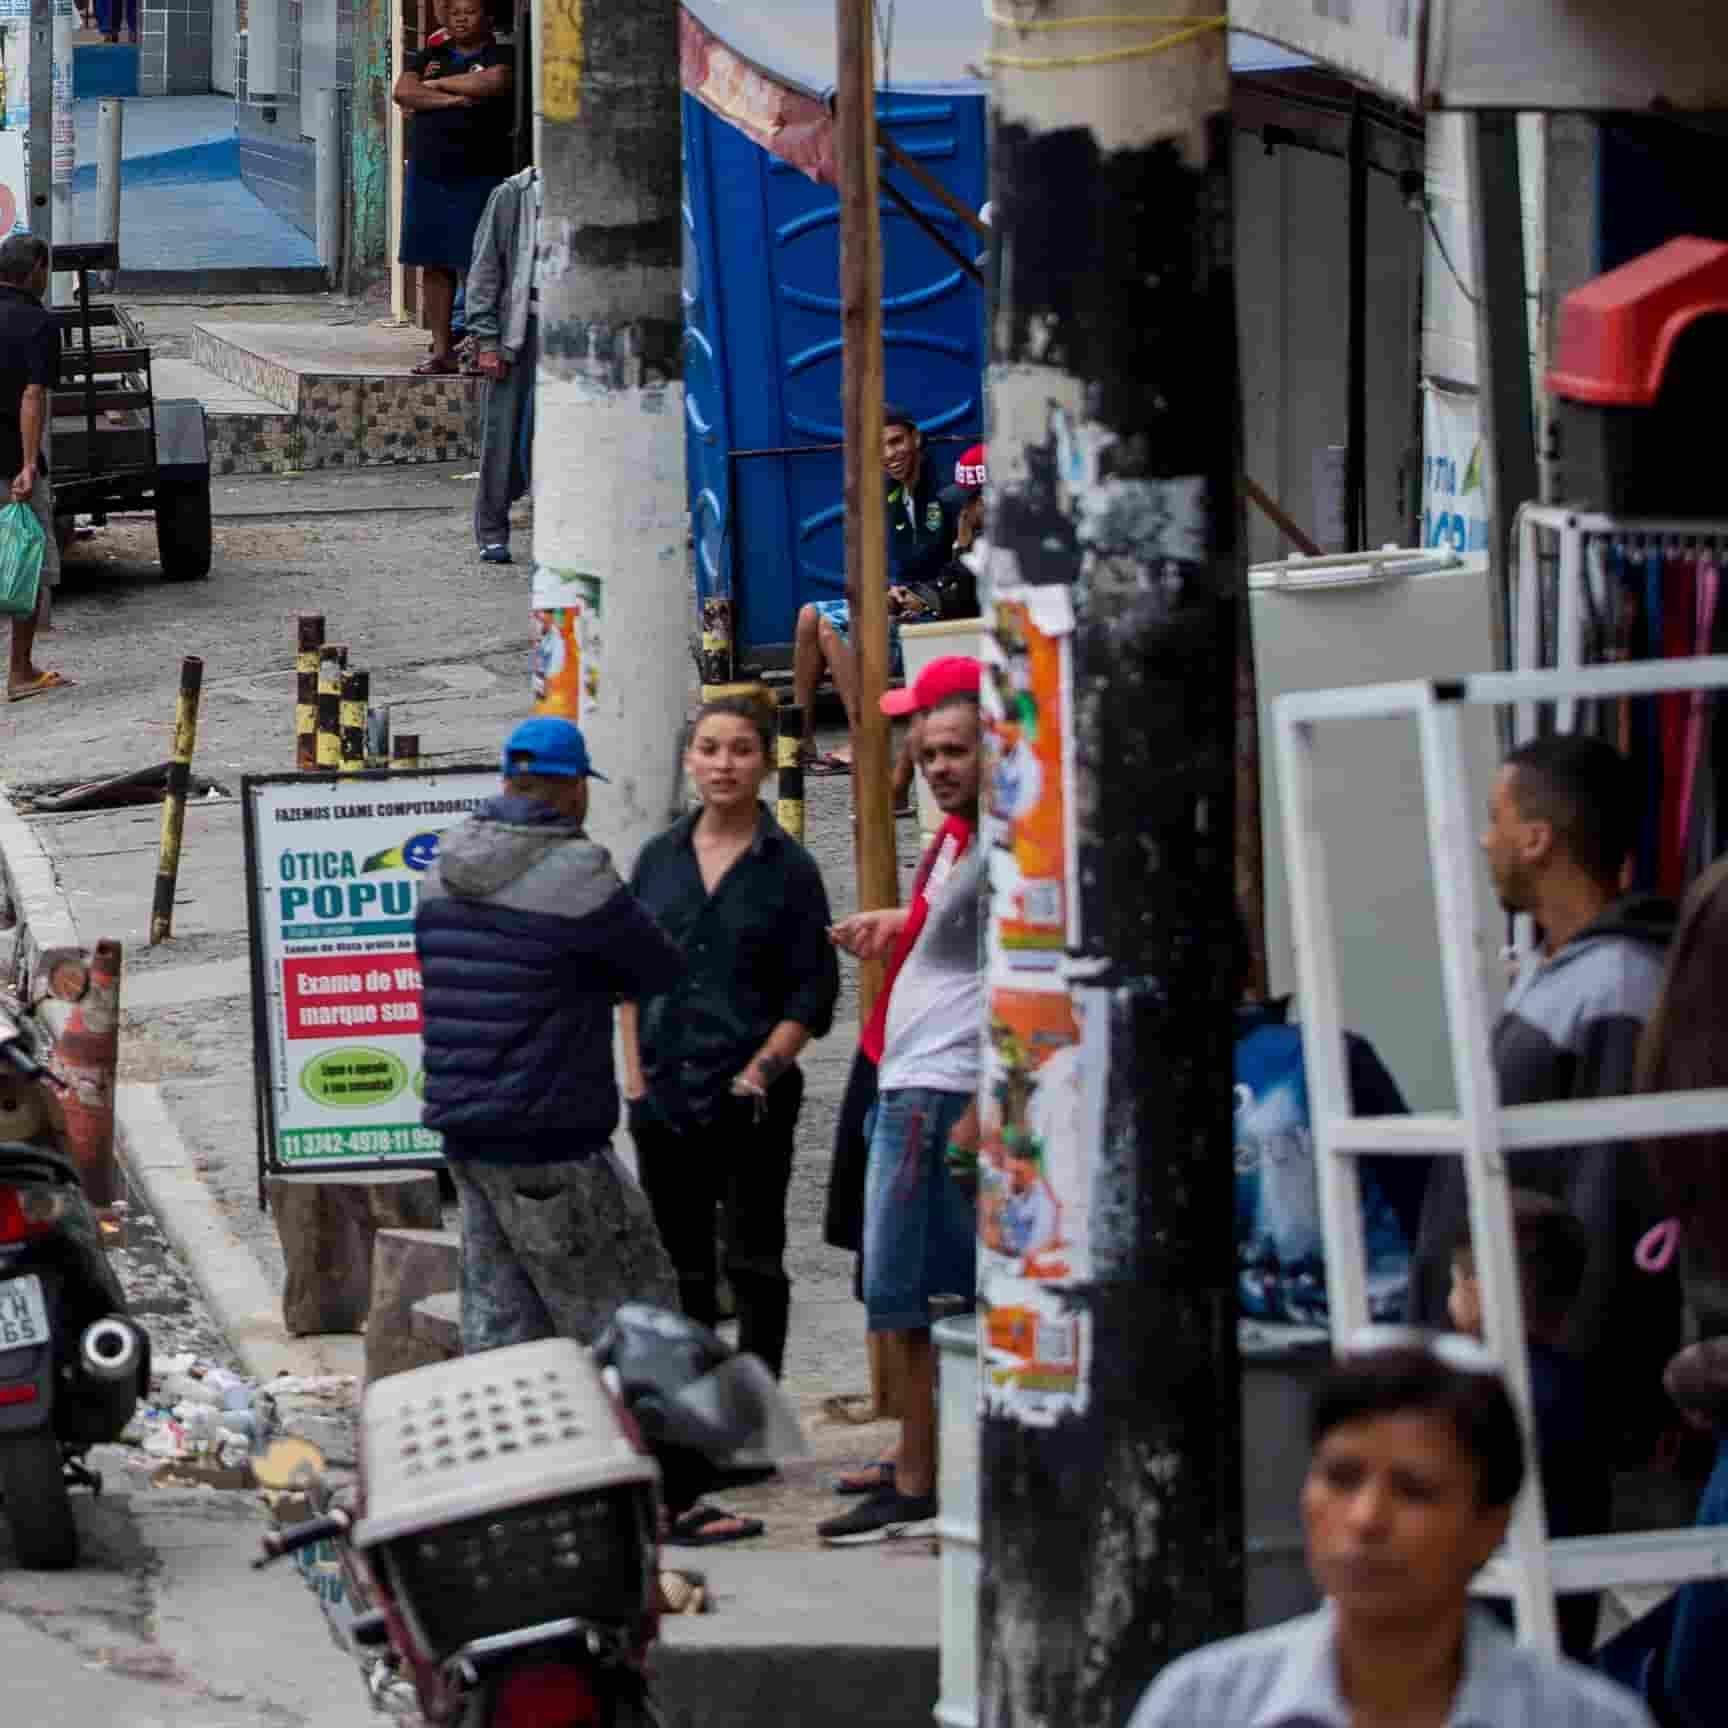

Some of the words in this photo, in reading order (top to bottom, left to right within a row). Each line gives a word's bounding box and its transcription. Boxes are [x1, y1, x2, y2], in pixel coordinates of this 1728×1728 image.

[275, 806, 329, 822] FAZEMOS
[334, 803, 374, 819] EXAME
[279, 847, 357, 881] ÓTICA
[297, 971, 362, 995] Exame
[365, 970, 392, 992] de
[299, 1005, 377, 1027] marque
[381, 1002, 419, 1022] sua
